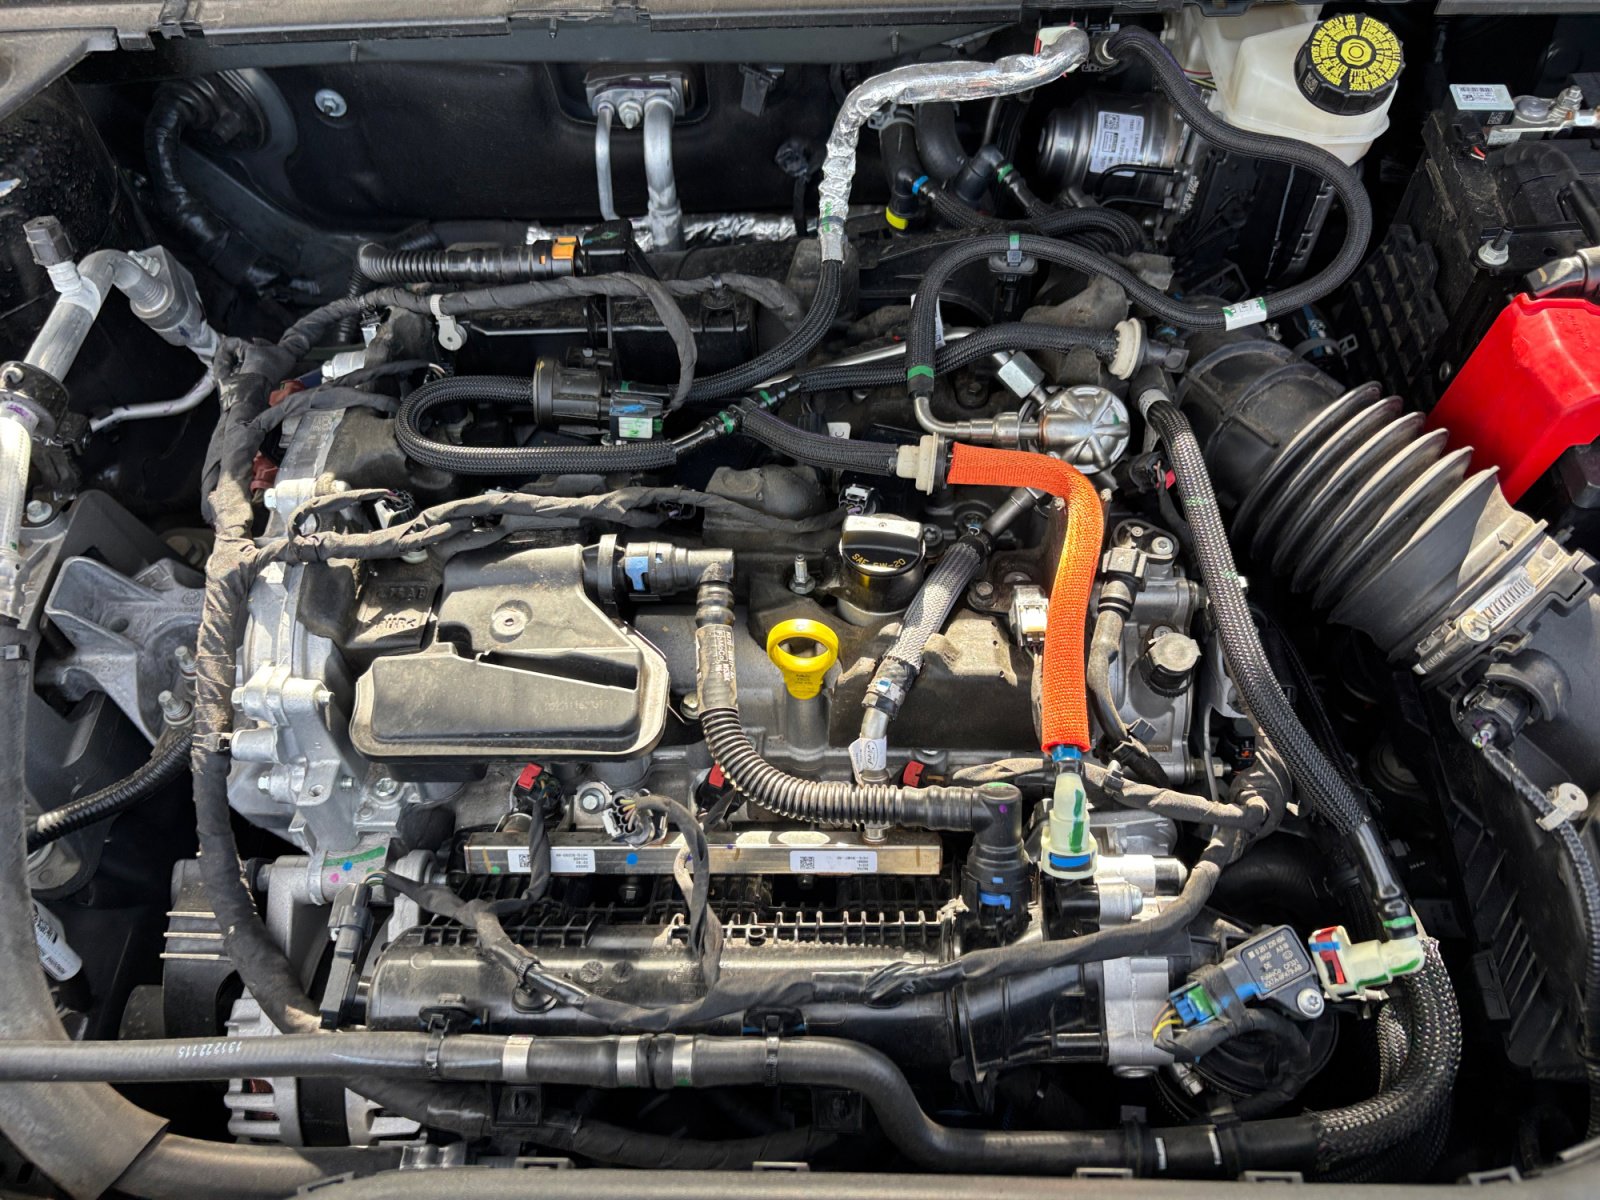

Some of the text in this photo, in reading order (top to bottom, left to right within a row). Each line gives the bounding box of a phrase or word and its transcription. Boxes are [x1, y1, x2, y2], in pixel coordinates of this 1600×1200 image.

[1323, 17, 1340, 30] FLUID
[1313, 27, 1327, 40] FROM
[1311, 45, 1322, 64] SEALED
[1315, 63, 1342, 86] CONTAINER
[851, 553, 870, 565] SAE
